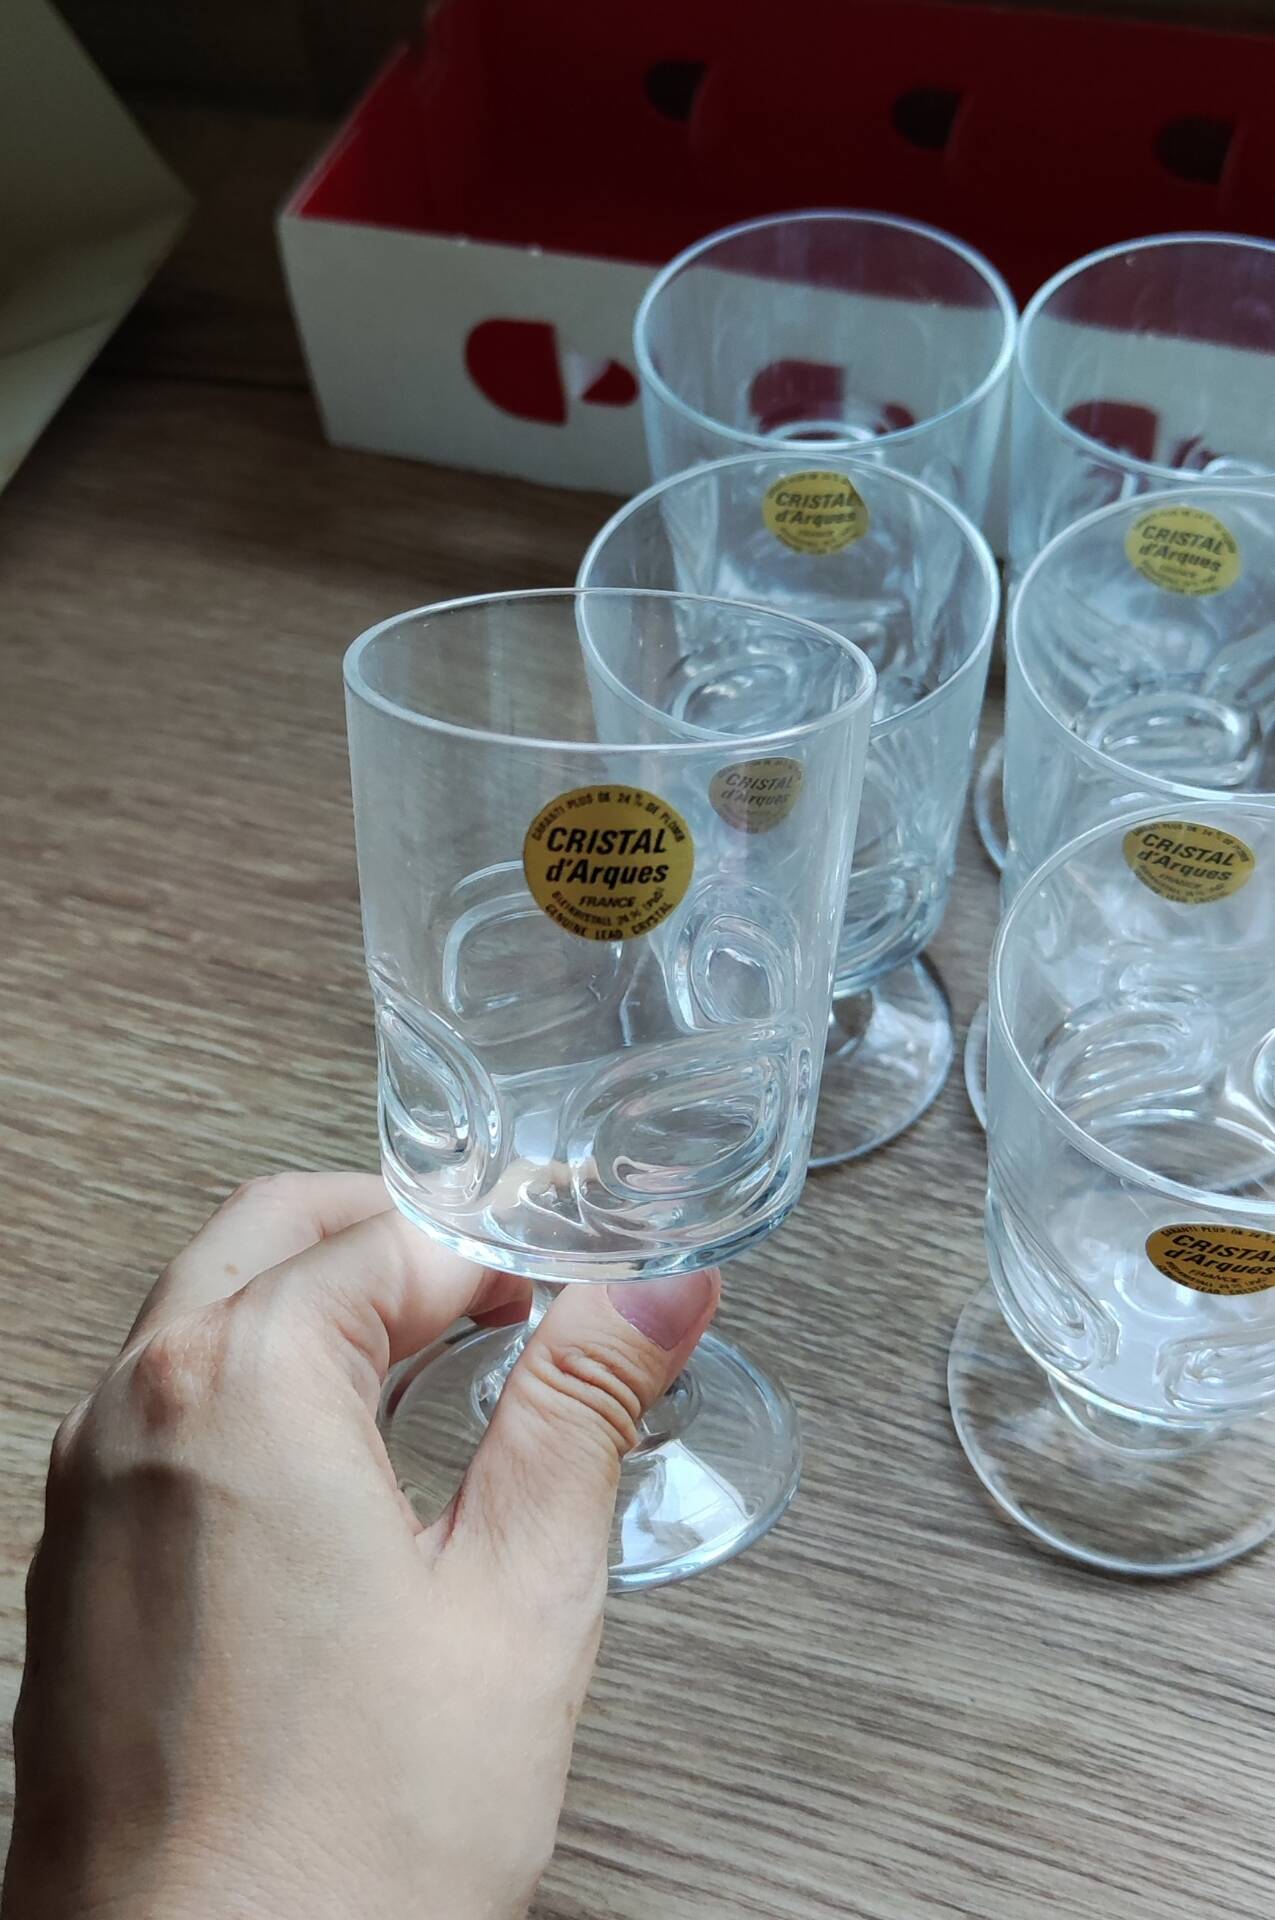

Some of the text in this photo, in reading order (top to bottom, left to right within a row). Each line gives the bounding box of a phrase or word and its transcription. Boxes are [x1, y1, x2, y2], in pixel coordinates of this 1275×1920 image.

[776, 491, 855, 509] CRISTAL
[775, 510, 857, 528] d'Arques
[1142, 525, 1224, 555] CRISTAL
[1138, 543, 1222, 573] d'Arques
[726, 773, 793, 791] CRISTAL
[720, 789, 791, 808] d'Arques
[567, 793, 593, 809] PLUS
[597, 791, 611, 803] DE
[617, 792, 631, 804] 24
[645, 802, 661, 815] DE
[660, 812, 686, 843] PLOMB
[547, 826, 668, 855] CRISTAL
[1142, 833, 1235, 866] CRISTAL
[545, 858, 669, 890] d'Arques
[1137, 850, 1233, 881] d'Arques
[578, 896, 637, 908] FRANCE
[545, 903, 674, 941] GENUINE LEAD CRYSTAL
[616, 913, 630, 926] 24
[1164, 1249, 1275, 1275] d'Arques
